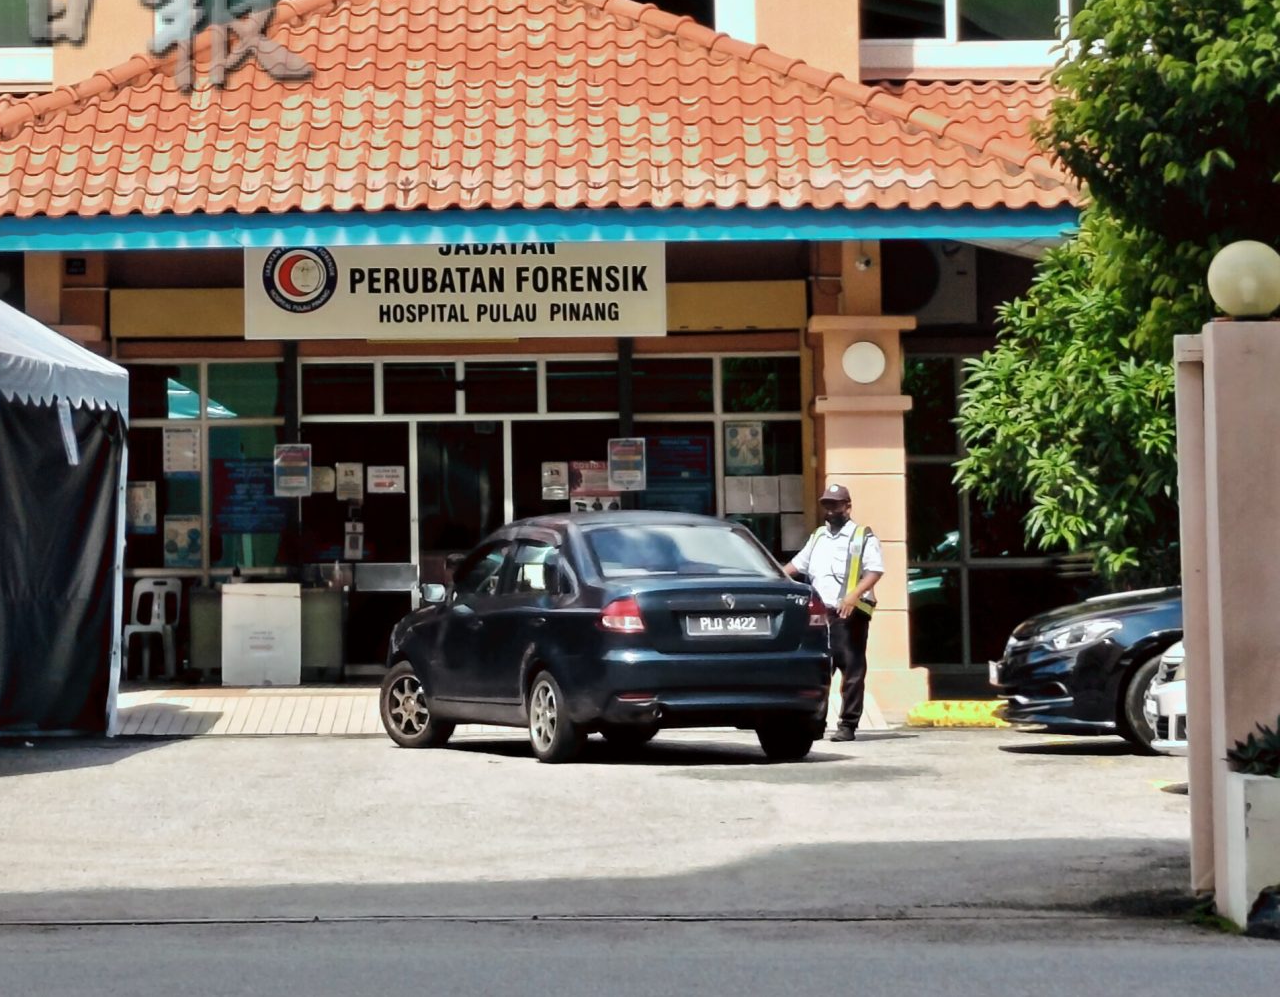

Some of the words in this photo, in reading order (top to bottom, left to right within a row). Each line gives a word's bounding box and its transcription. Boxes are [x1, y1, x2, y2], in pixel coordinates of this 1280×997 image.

[349, 267, 505, 294] PERUBATAN
[516, 265, 648, 293] FORENSIK
[379, 303, 469, 323] HOSPITAL
[477, 303, 537, 322] PULAU
[550, 302, 619, 321] PINANG
